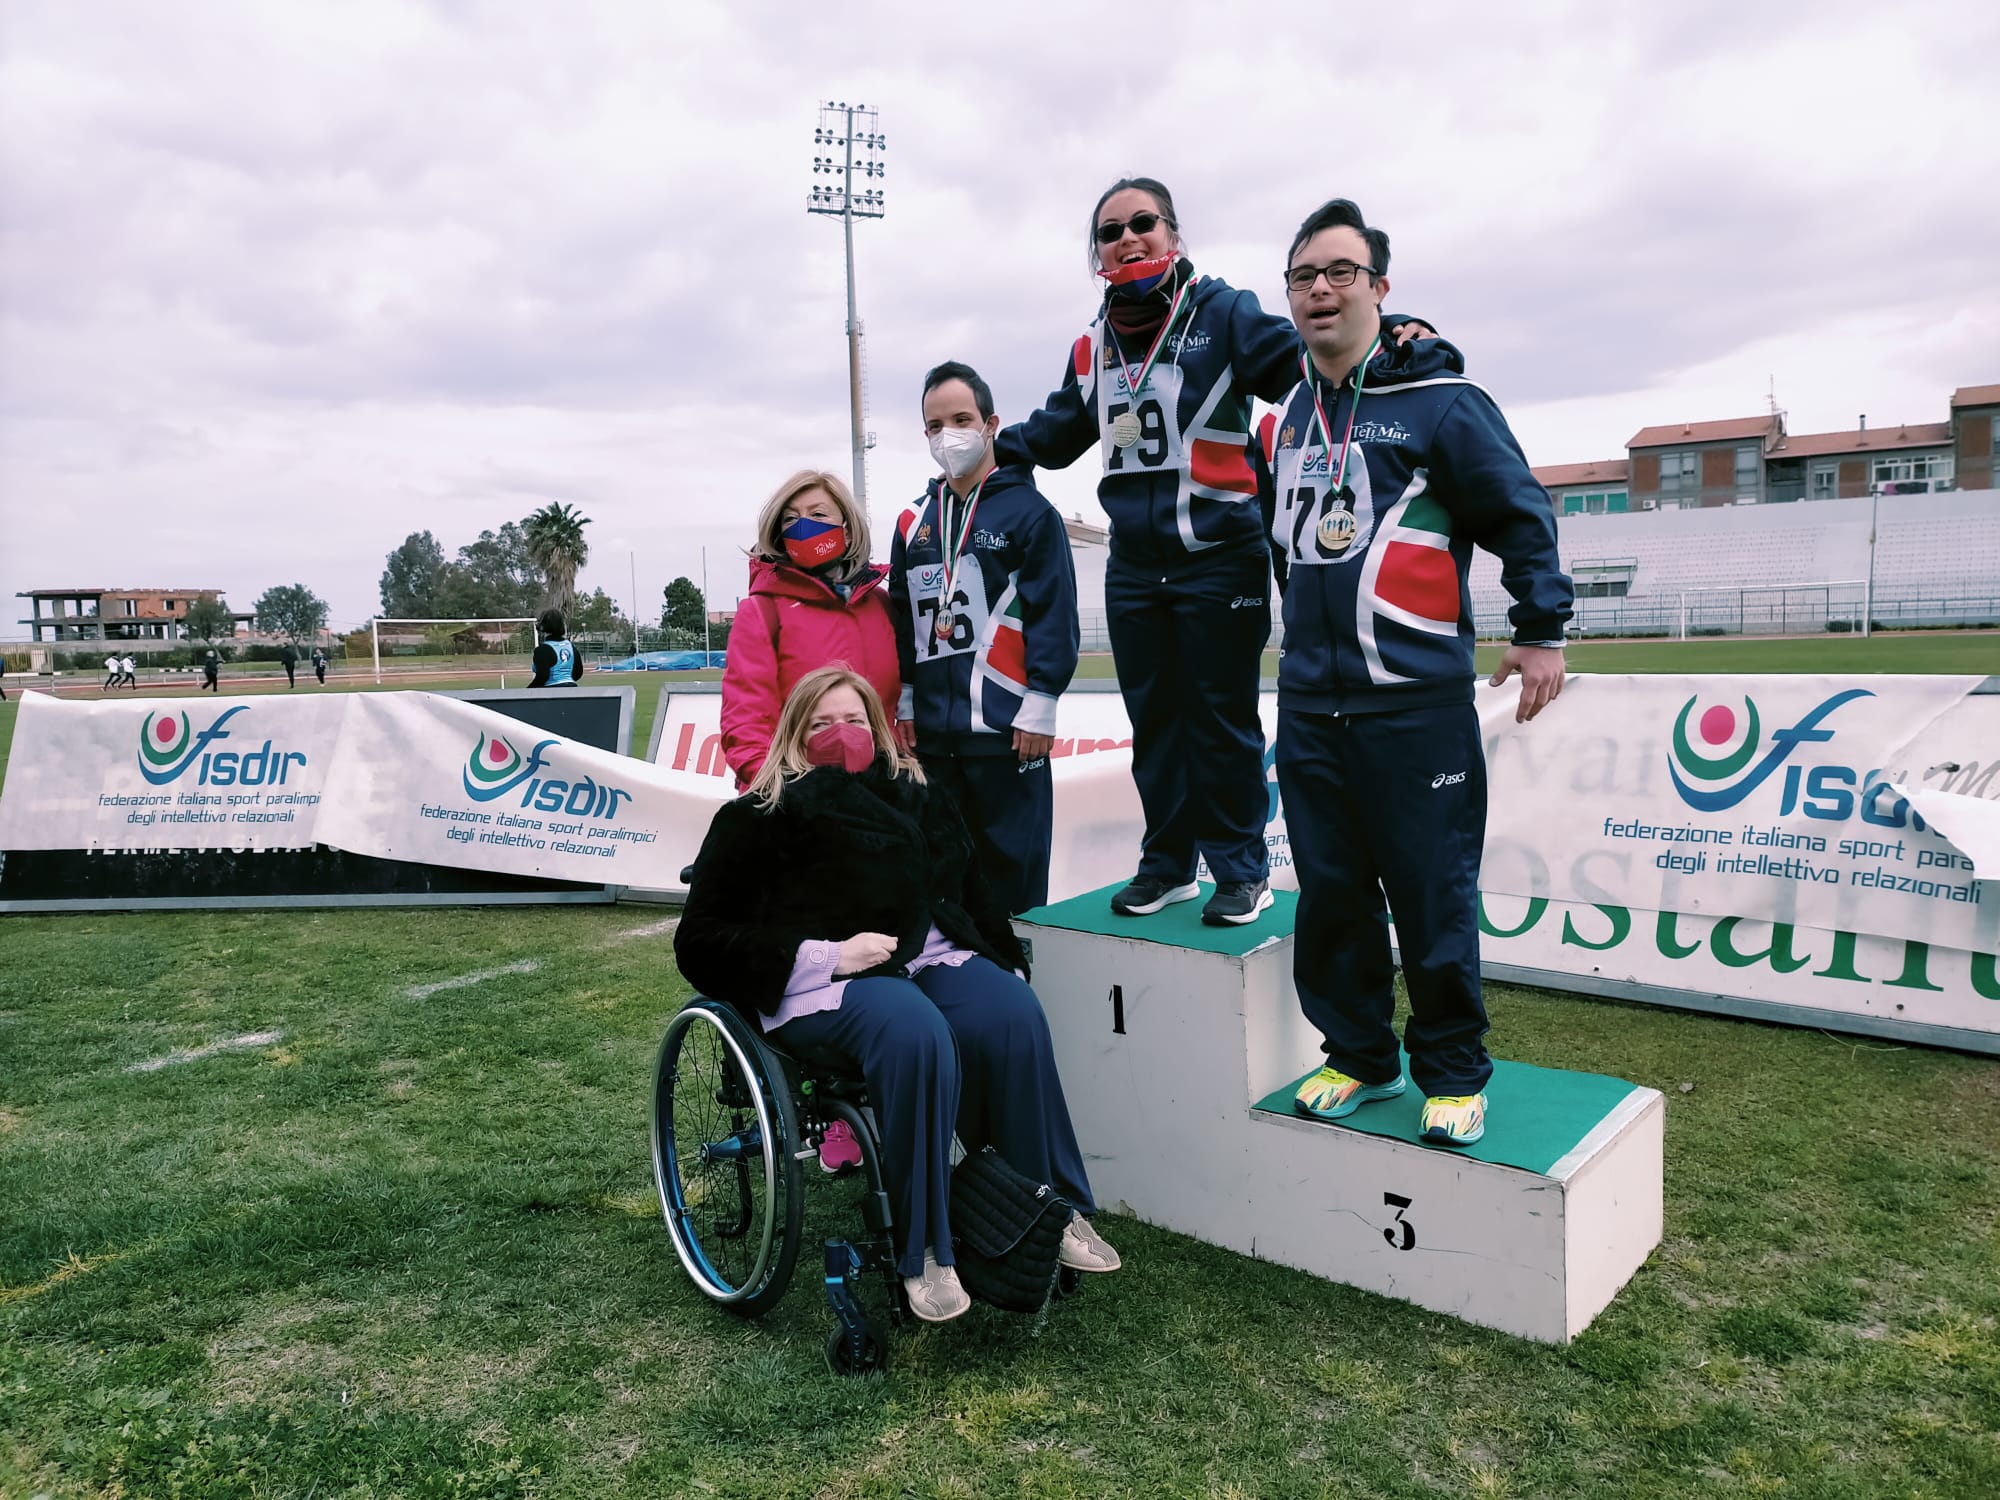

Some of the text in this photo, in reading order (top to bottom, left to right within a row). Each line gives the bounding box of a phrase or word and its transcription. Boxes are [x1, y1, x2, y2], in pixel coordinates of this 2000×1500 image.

[1107, 399, 1169, 470] 79
[917, 590, 975, 657] 76
[98, 792, 172, 807] federazione
[177, 791, 222, 806] italiana
[226, 791, 261, 807] sport
[1445, 771, 1466, 786] asics
[127, 809, 295, 826] degli intellettivo relazionali
[420, 803, 659, 844] federazione italiana sport paralimpici
[1603, 817, 1733, 845] federazione
[1742, 823, 1827, 853] italiana
[1837, 839, 1907, 862] sport
[446, 826, 618, 858] degli intellettivo relazionali
[1655, 850, 1983, 905] degli intellettivo relazionali
[1108, 984, 1126, 1035] 1
[1383, 1191, 1416, 1251] 3
